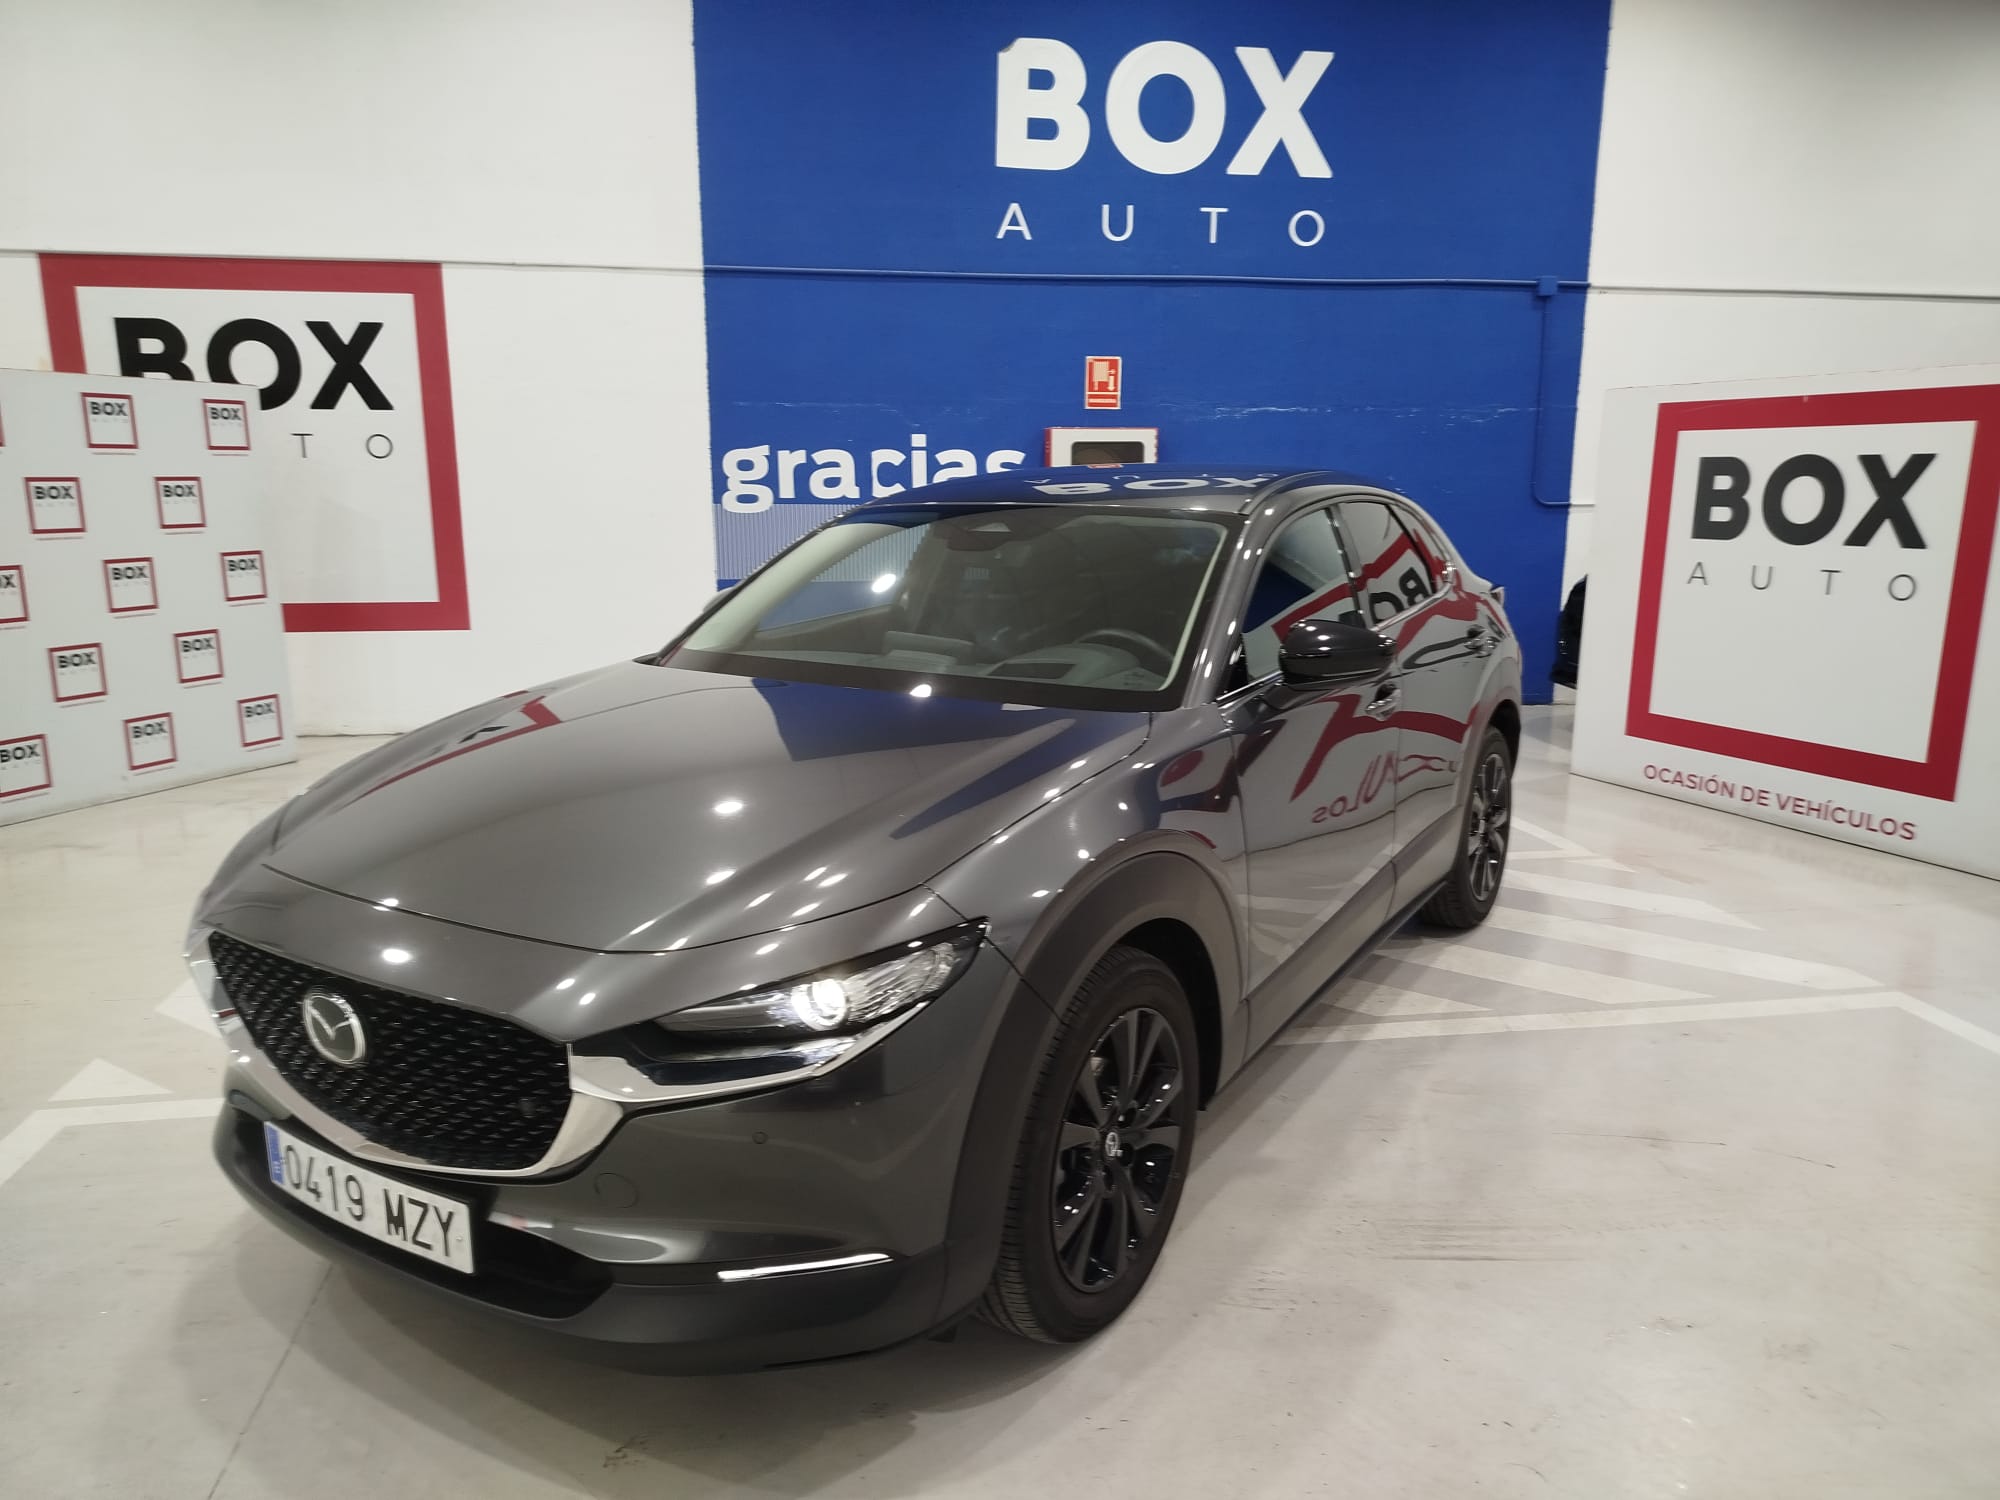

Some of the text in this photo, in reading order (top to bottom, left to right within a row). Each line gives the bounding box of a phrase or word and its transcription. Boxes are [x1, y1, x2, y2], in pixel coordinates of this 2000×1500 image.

[995, 36, 1334, 179] BOX
[996, 202, 1326, 247] AUTO
[114, 316, 395, 411] BOX
[90, 401, 128, 416] BOX
[209, 407, 241, 420] BOX
[33, 485, 74, 500] BOX
[162, 484, 197, 498] BOX
[1690, 453, 1937, 550] BOX
[111, 565, 148, 580] BOX
[227, 558, 258, 572] BOX
[1686, 561, 1917, 601] AUTO
[181, 637, 215, 652] BOX
[57, 651, 97, 668] BOX
[244, 702, 275, 718] BOX
[132, 720, 168, 738] BOX
[0, 743, 40, 762] BOX
[1643, 763, 1918, 841] OCASIÓN DE VEHÍCULOS
[285, 1144, 454, 1257] 0419 MZY
